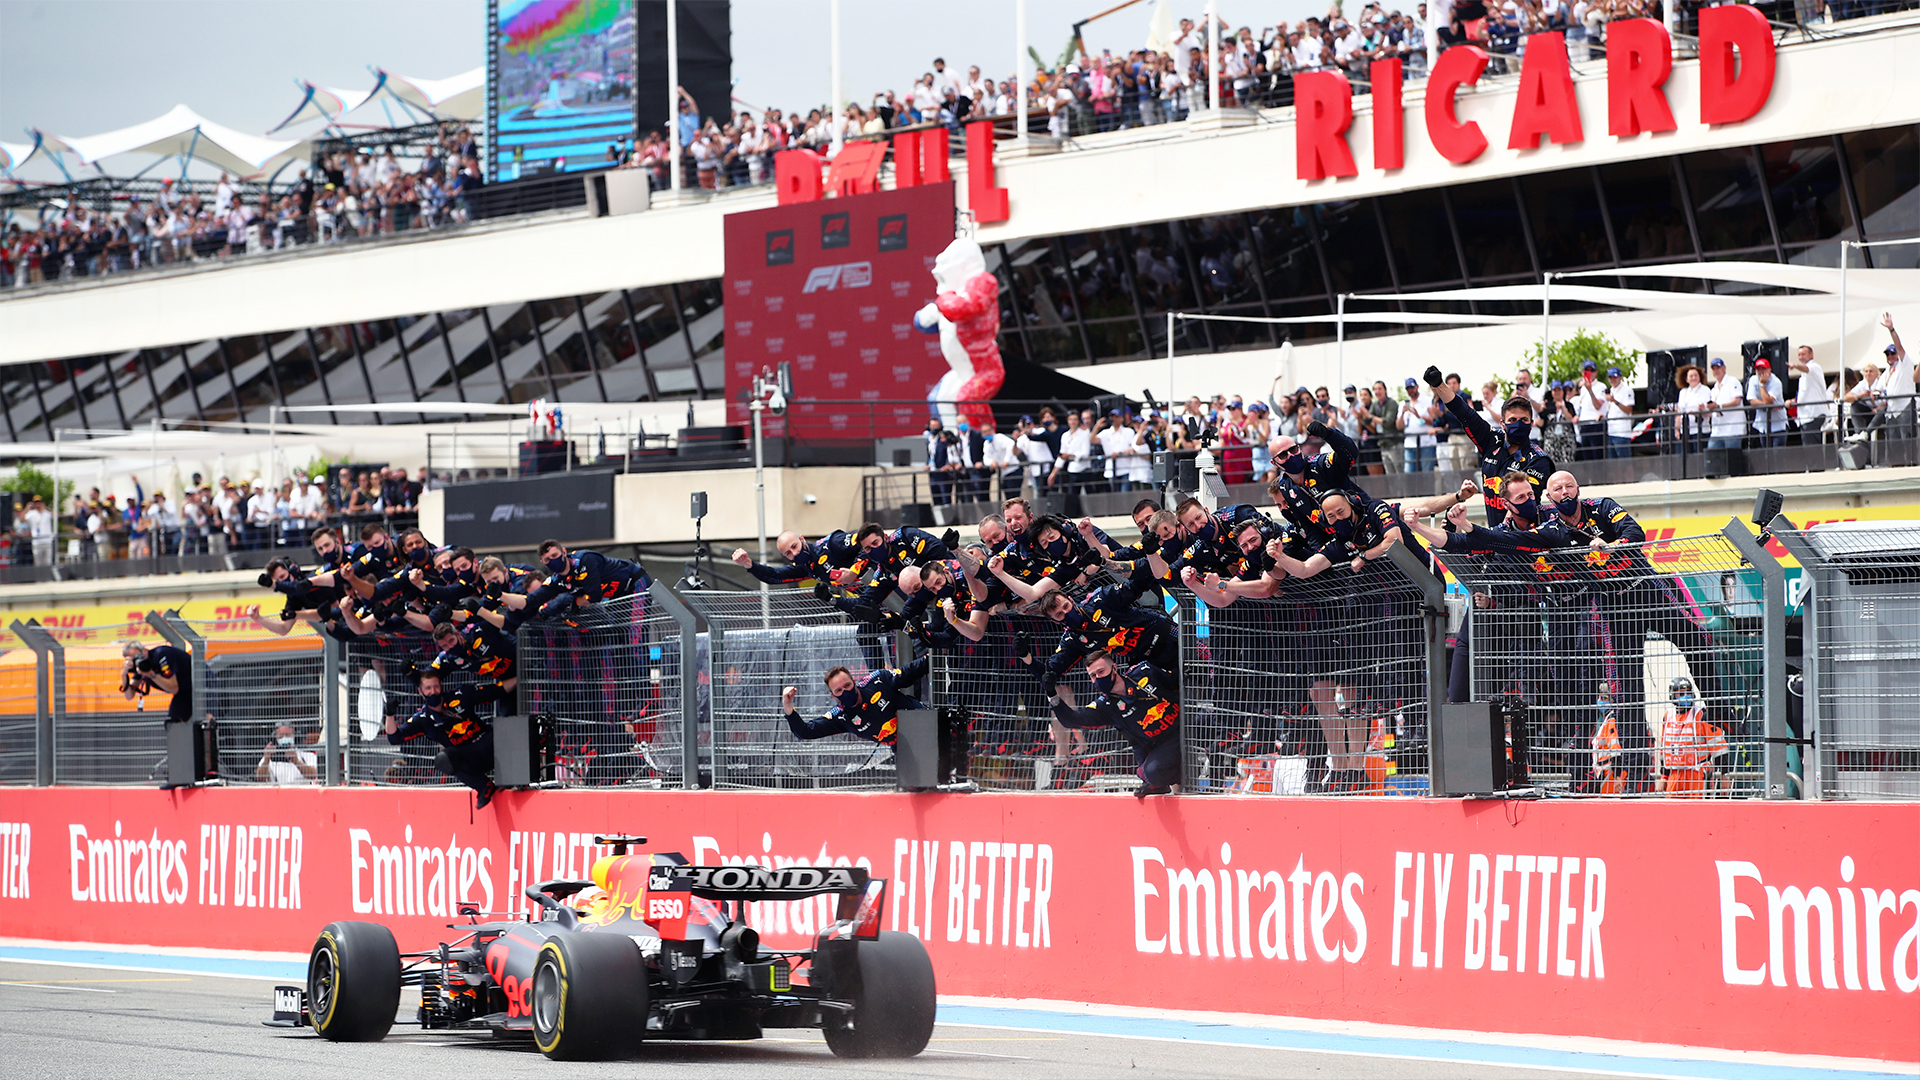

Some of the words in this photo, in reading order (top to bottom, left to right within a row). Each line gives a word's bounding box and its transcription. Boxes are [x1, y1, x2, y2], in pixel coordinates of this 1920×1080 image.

[1294, 4, 1776, 181] RICARD
[0, 822, 31, 899] TER
[69, 820, 188, 904] Emirates
[199, 824, 230, 906] FLY
[234, 825, 303, 909] BETTER
[349, 824, 494, 918] Emirates
[508, 830, 546, 921] FLY
[673, 867, 858, 890] HONDA
[891, 838, 939, 941] FLY
[947, 841, 1054, 948] BETTER
[649, 899, 684, 919] ESSO
[1130, 841, 1368, 964] Emirates
[1392, 851, 1454, 968] FLY
[1464, 853, 1607, 979] BETTER
